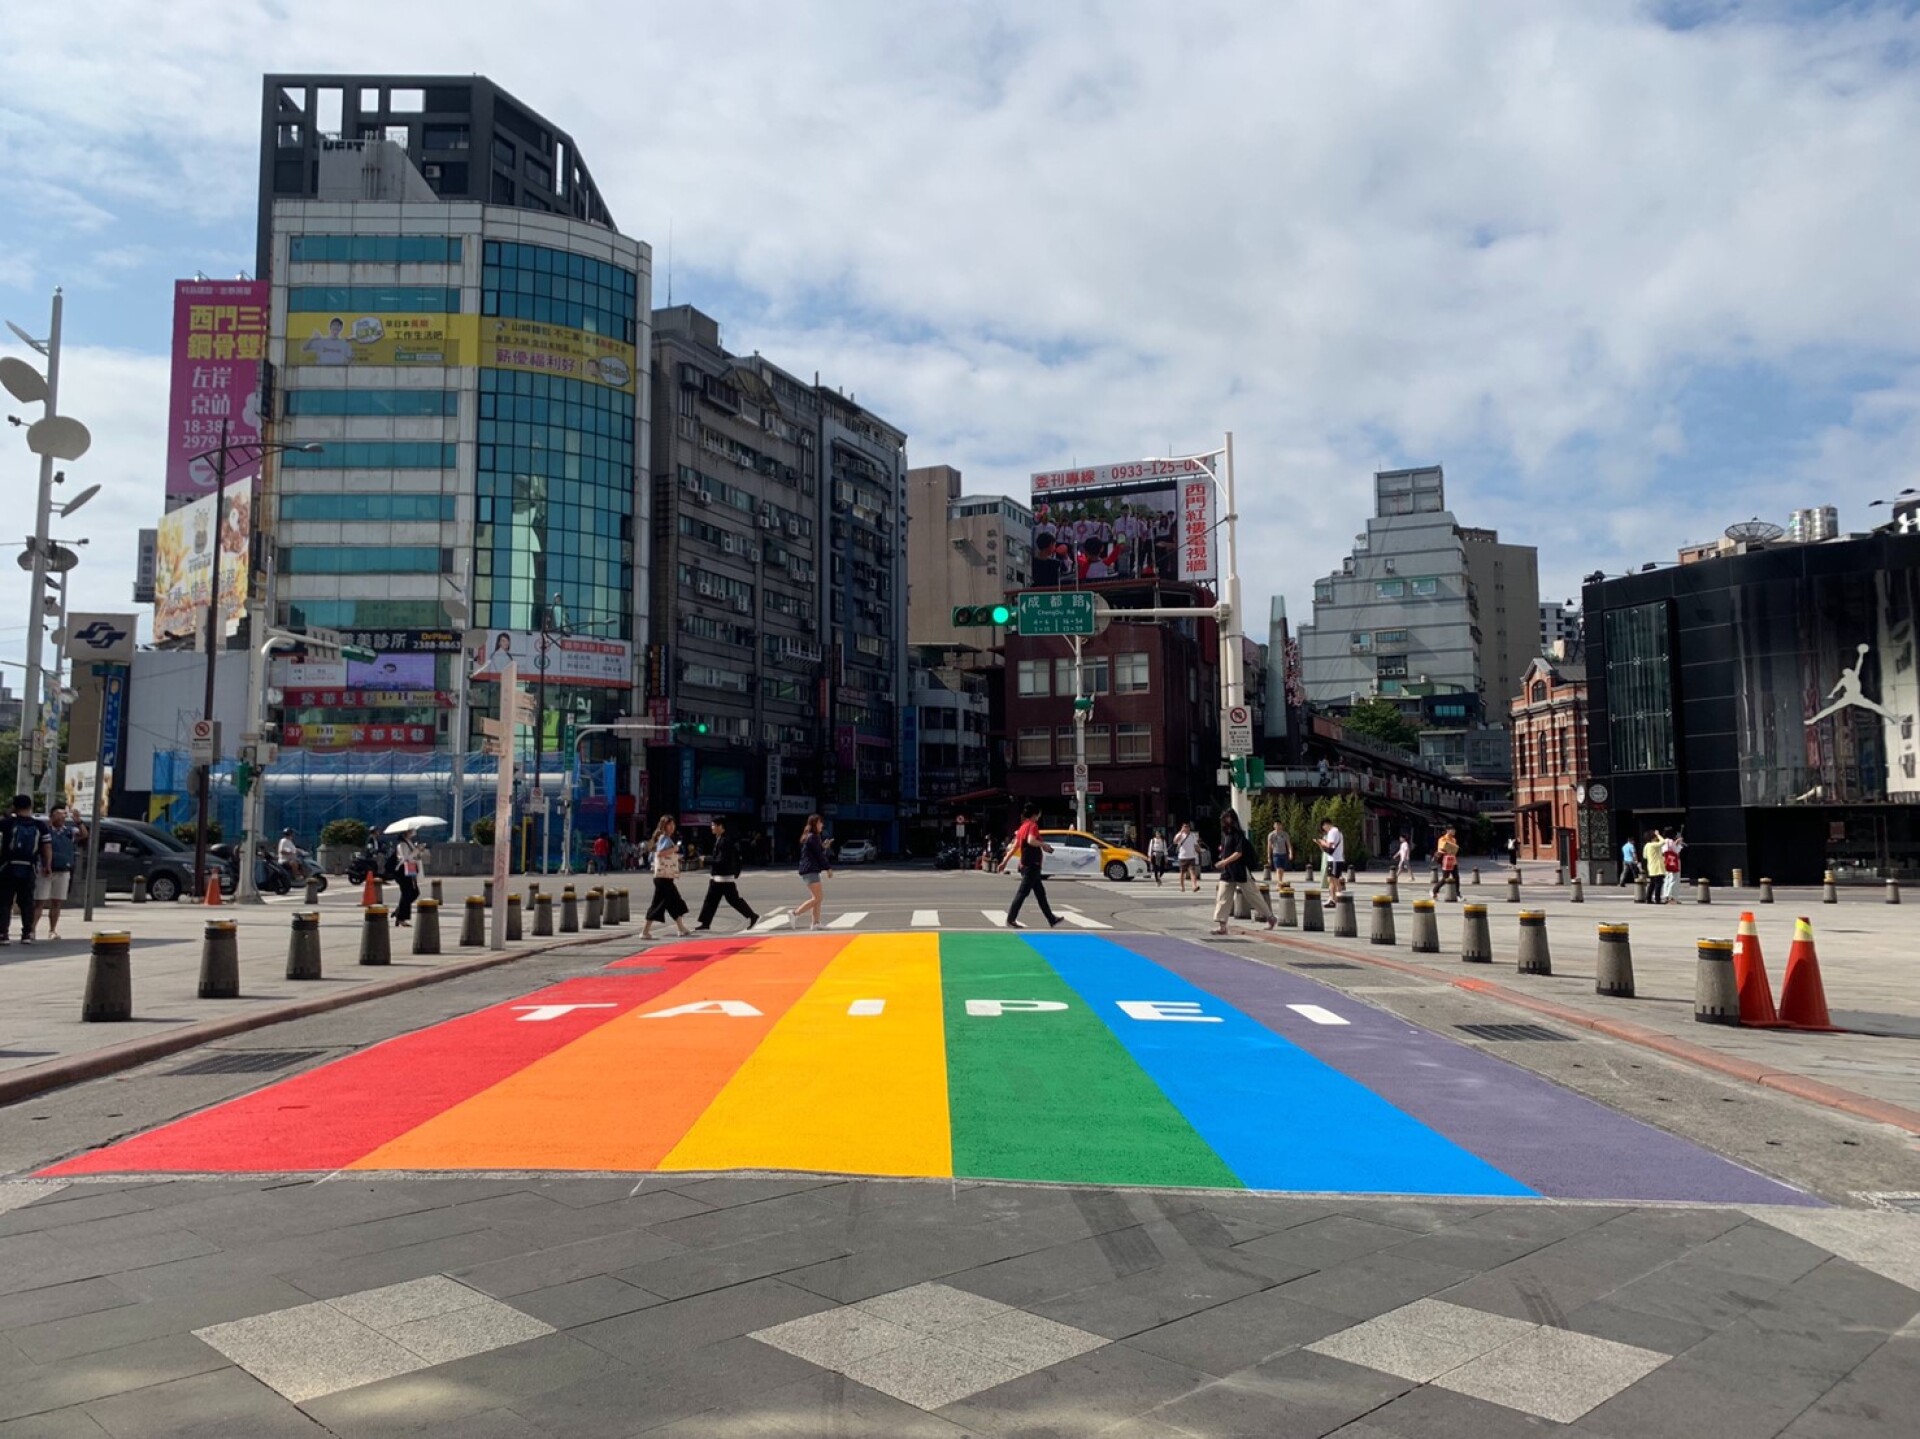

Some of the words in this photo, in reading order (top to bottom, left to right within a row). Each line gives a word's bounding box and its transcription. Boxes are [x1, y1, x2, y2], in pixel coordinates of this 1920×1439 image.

[190, 305, 267, 331] 西門三
[191, 366, 232, 388] 左岸
[191, 393, 231, 415] 京站
[1185, 483, 1208, 573] 西門紅樓電視牆
[510, 999, 1352, 1025] TAIPEI
